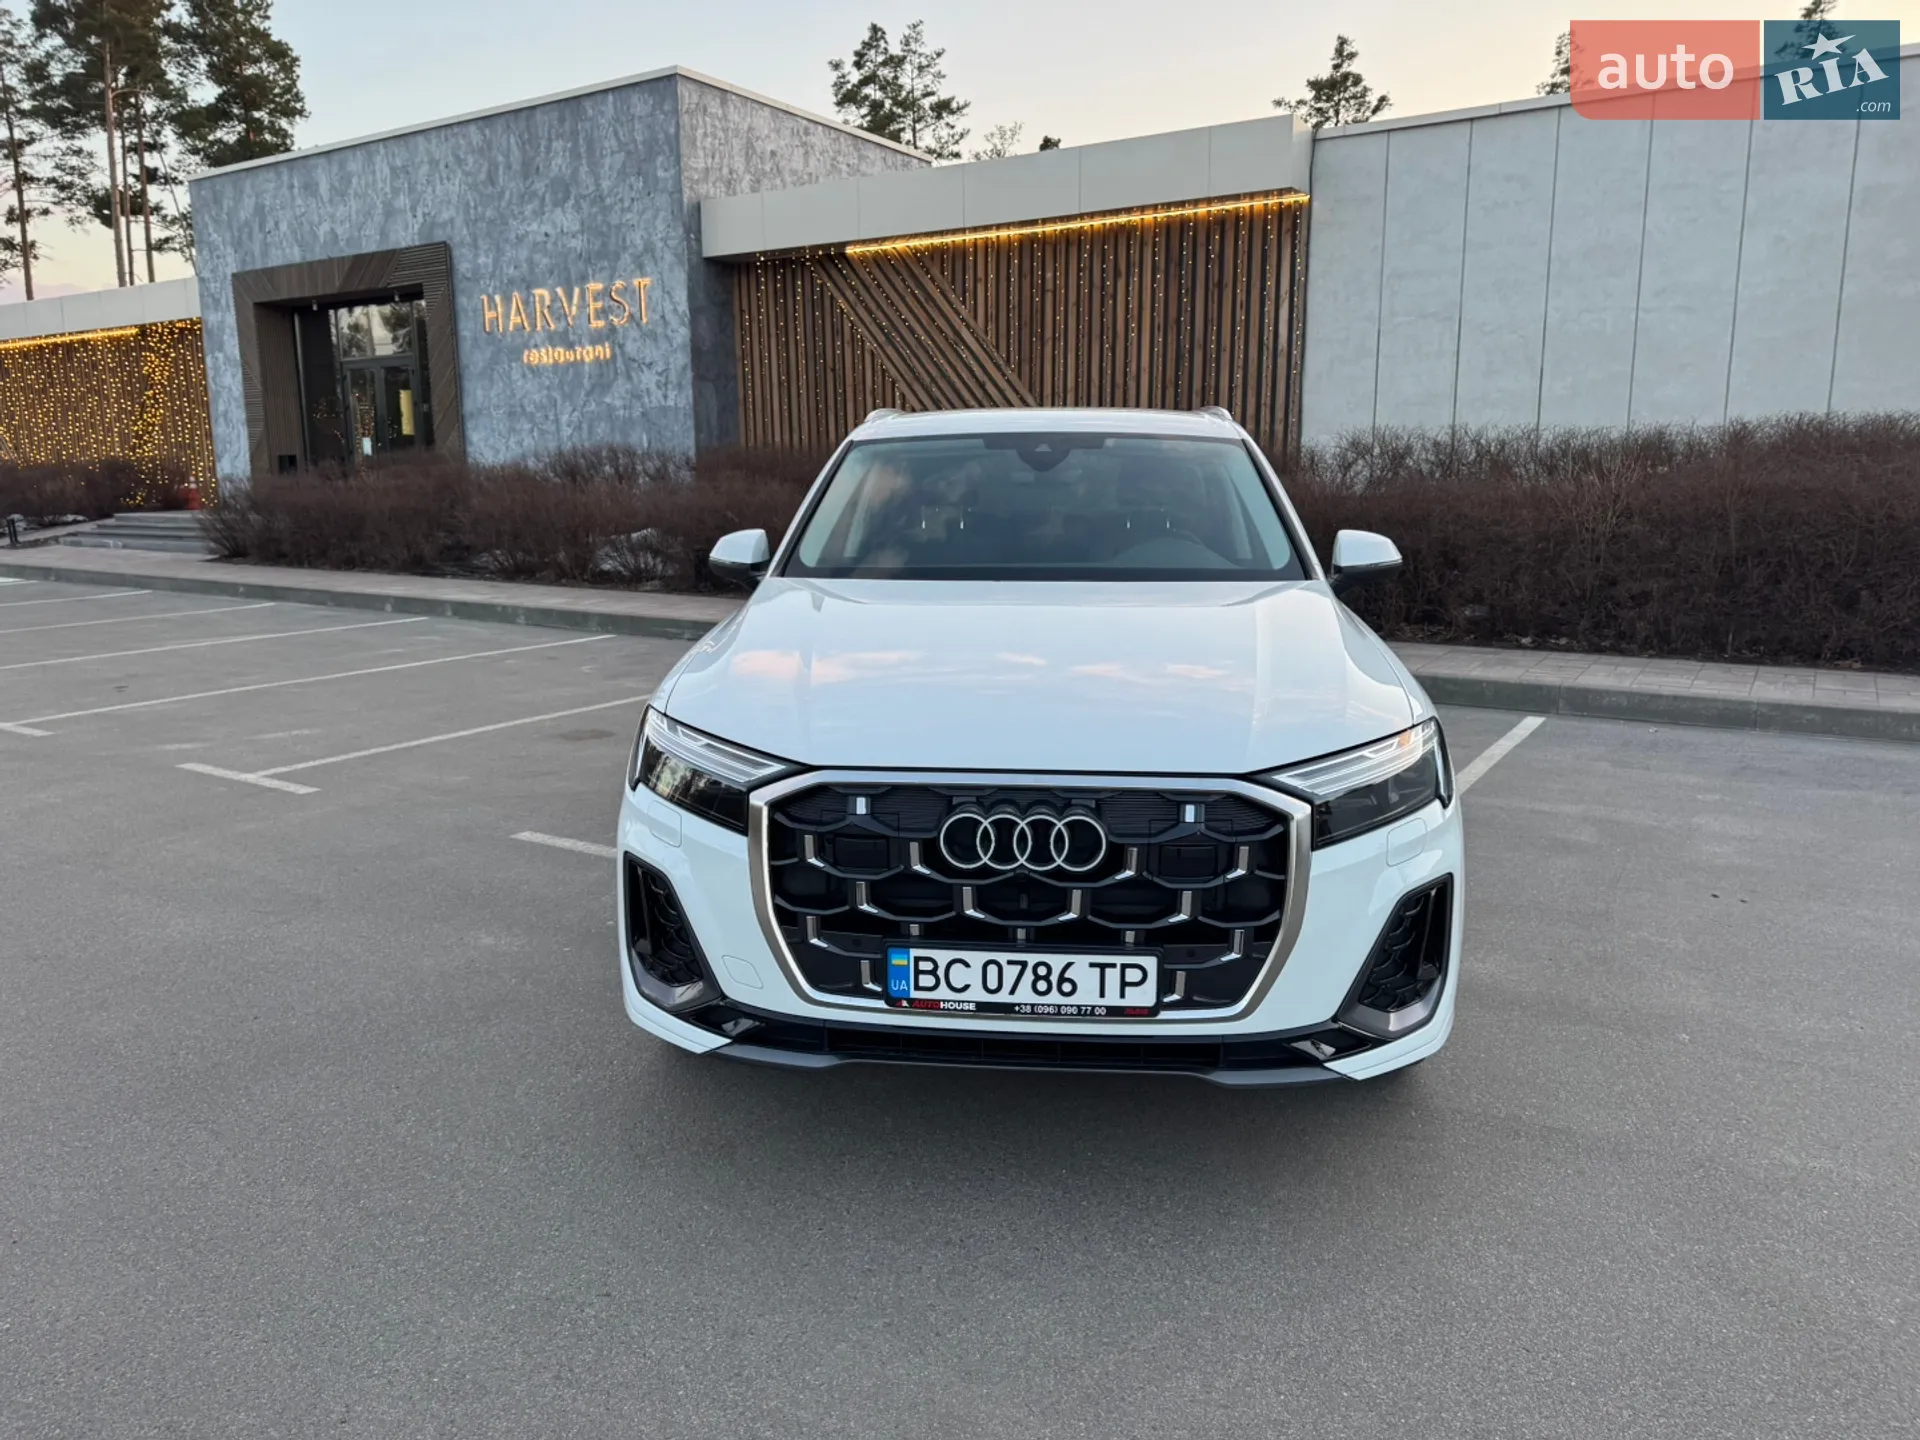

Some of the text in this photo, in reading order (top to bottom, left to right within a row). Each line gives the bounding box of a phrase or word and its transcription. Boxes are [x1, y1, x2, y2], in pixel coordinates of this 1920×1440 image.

[481, 278, 652, 334] HARVEST
[523, 341, 612, 365] restaurant
[891, 979, 909, 991] UA
[913, 956, 1148, 999] BC 0786 TP
[1014, 1005, 1032, 1013] +38
[1080, 1007, 1092, 1015] 77
[1094, 1006, 1107, 1015] 00
